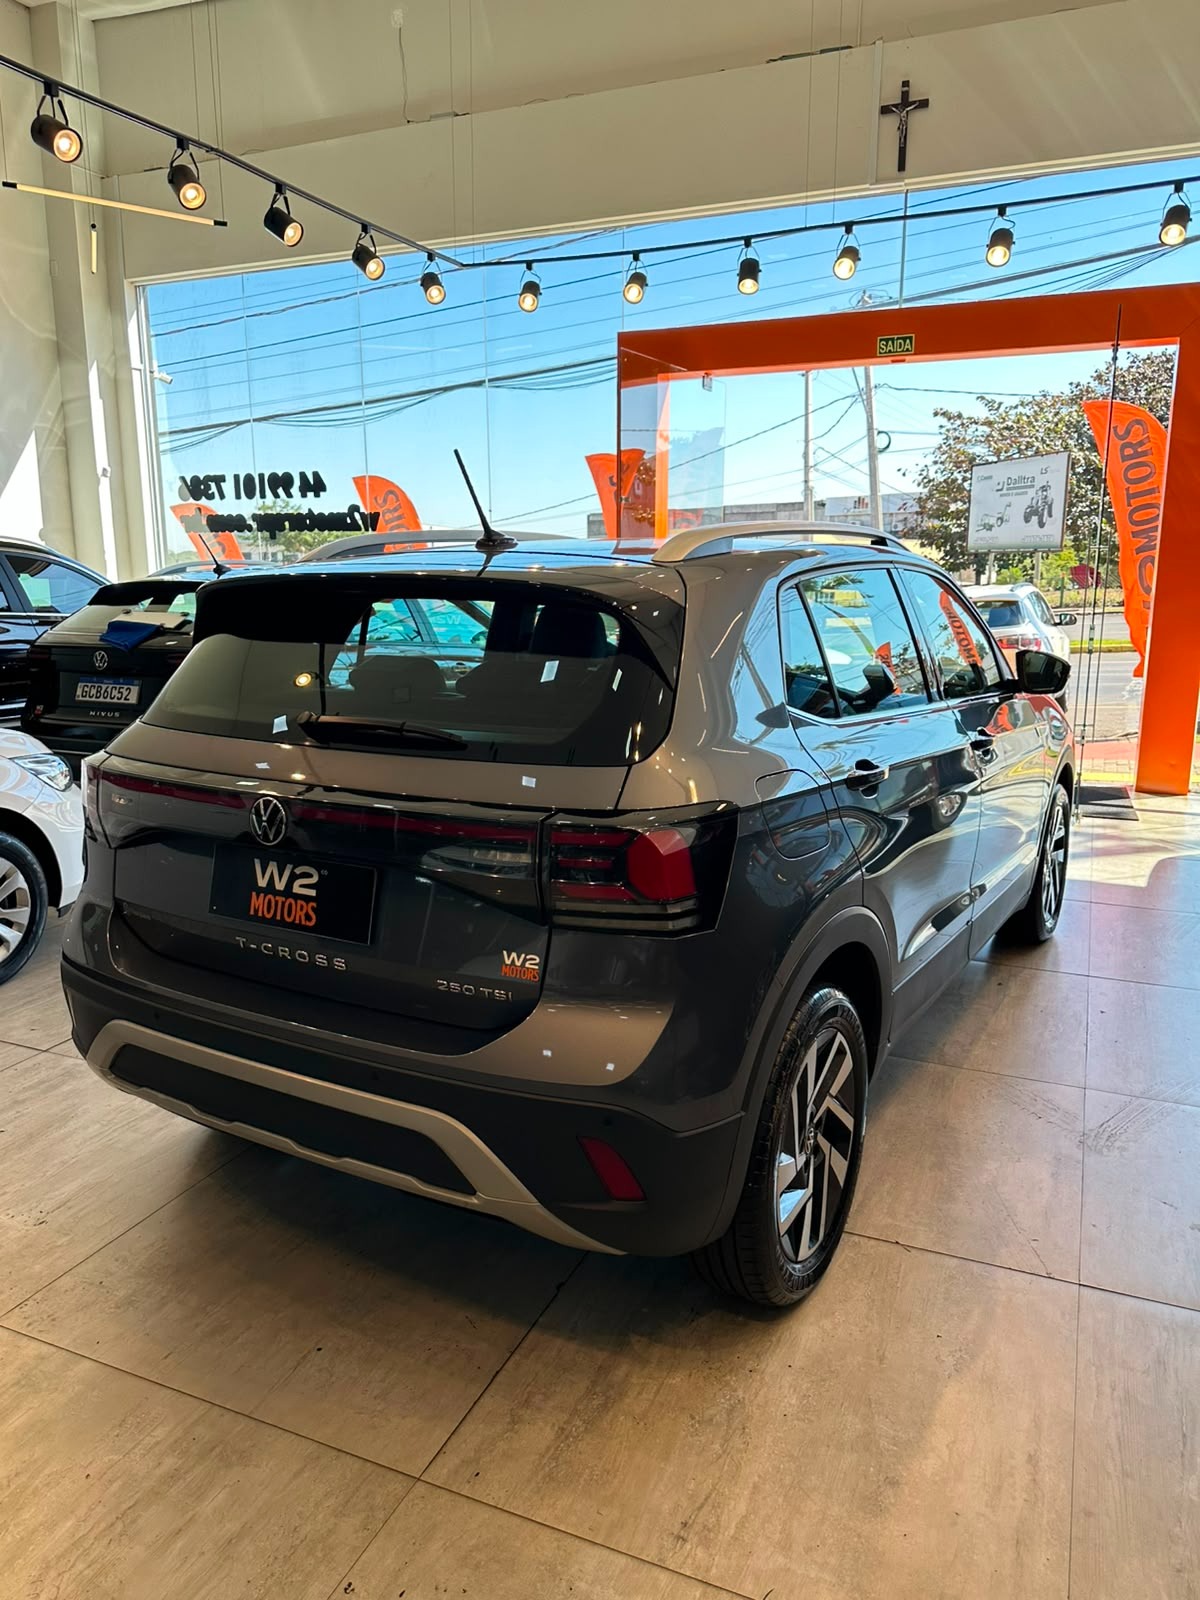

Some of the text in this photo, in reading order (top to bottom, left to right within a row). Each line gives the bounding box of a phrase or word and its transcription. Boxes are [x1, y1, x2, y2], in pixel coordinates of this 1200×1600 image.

[880, 337, 911, 353] SAÍDA
[1113, 418, 1160, 554] MOTORS
[80, 684, 132, 701] GCB6C52
[254, 858, 319, 896] W2
[250, 891, 317, 927] MOTORS
[235, 936, 347, 971] T-CROSS
[503, 950, 540, 969] W2
[501, 965, 539, 982] MOTORS
[437, 979, 513, 1002] 250 TSI
